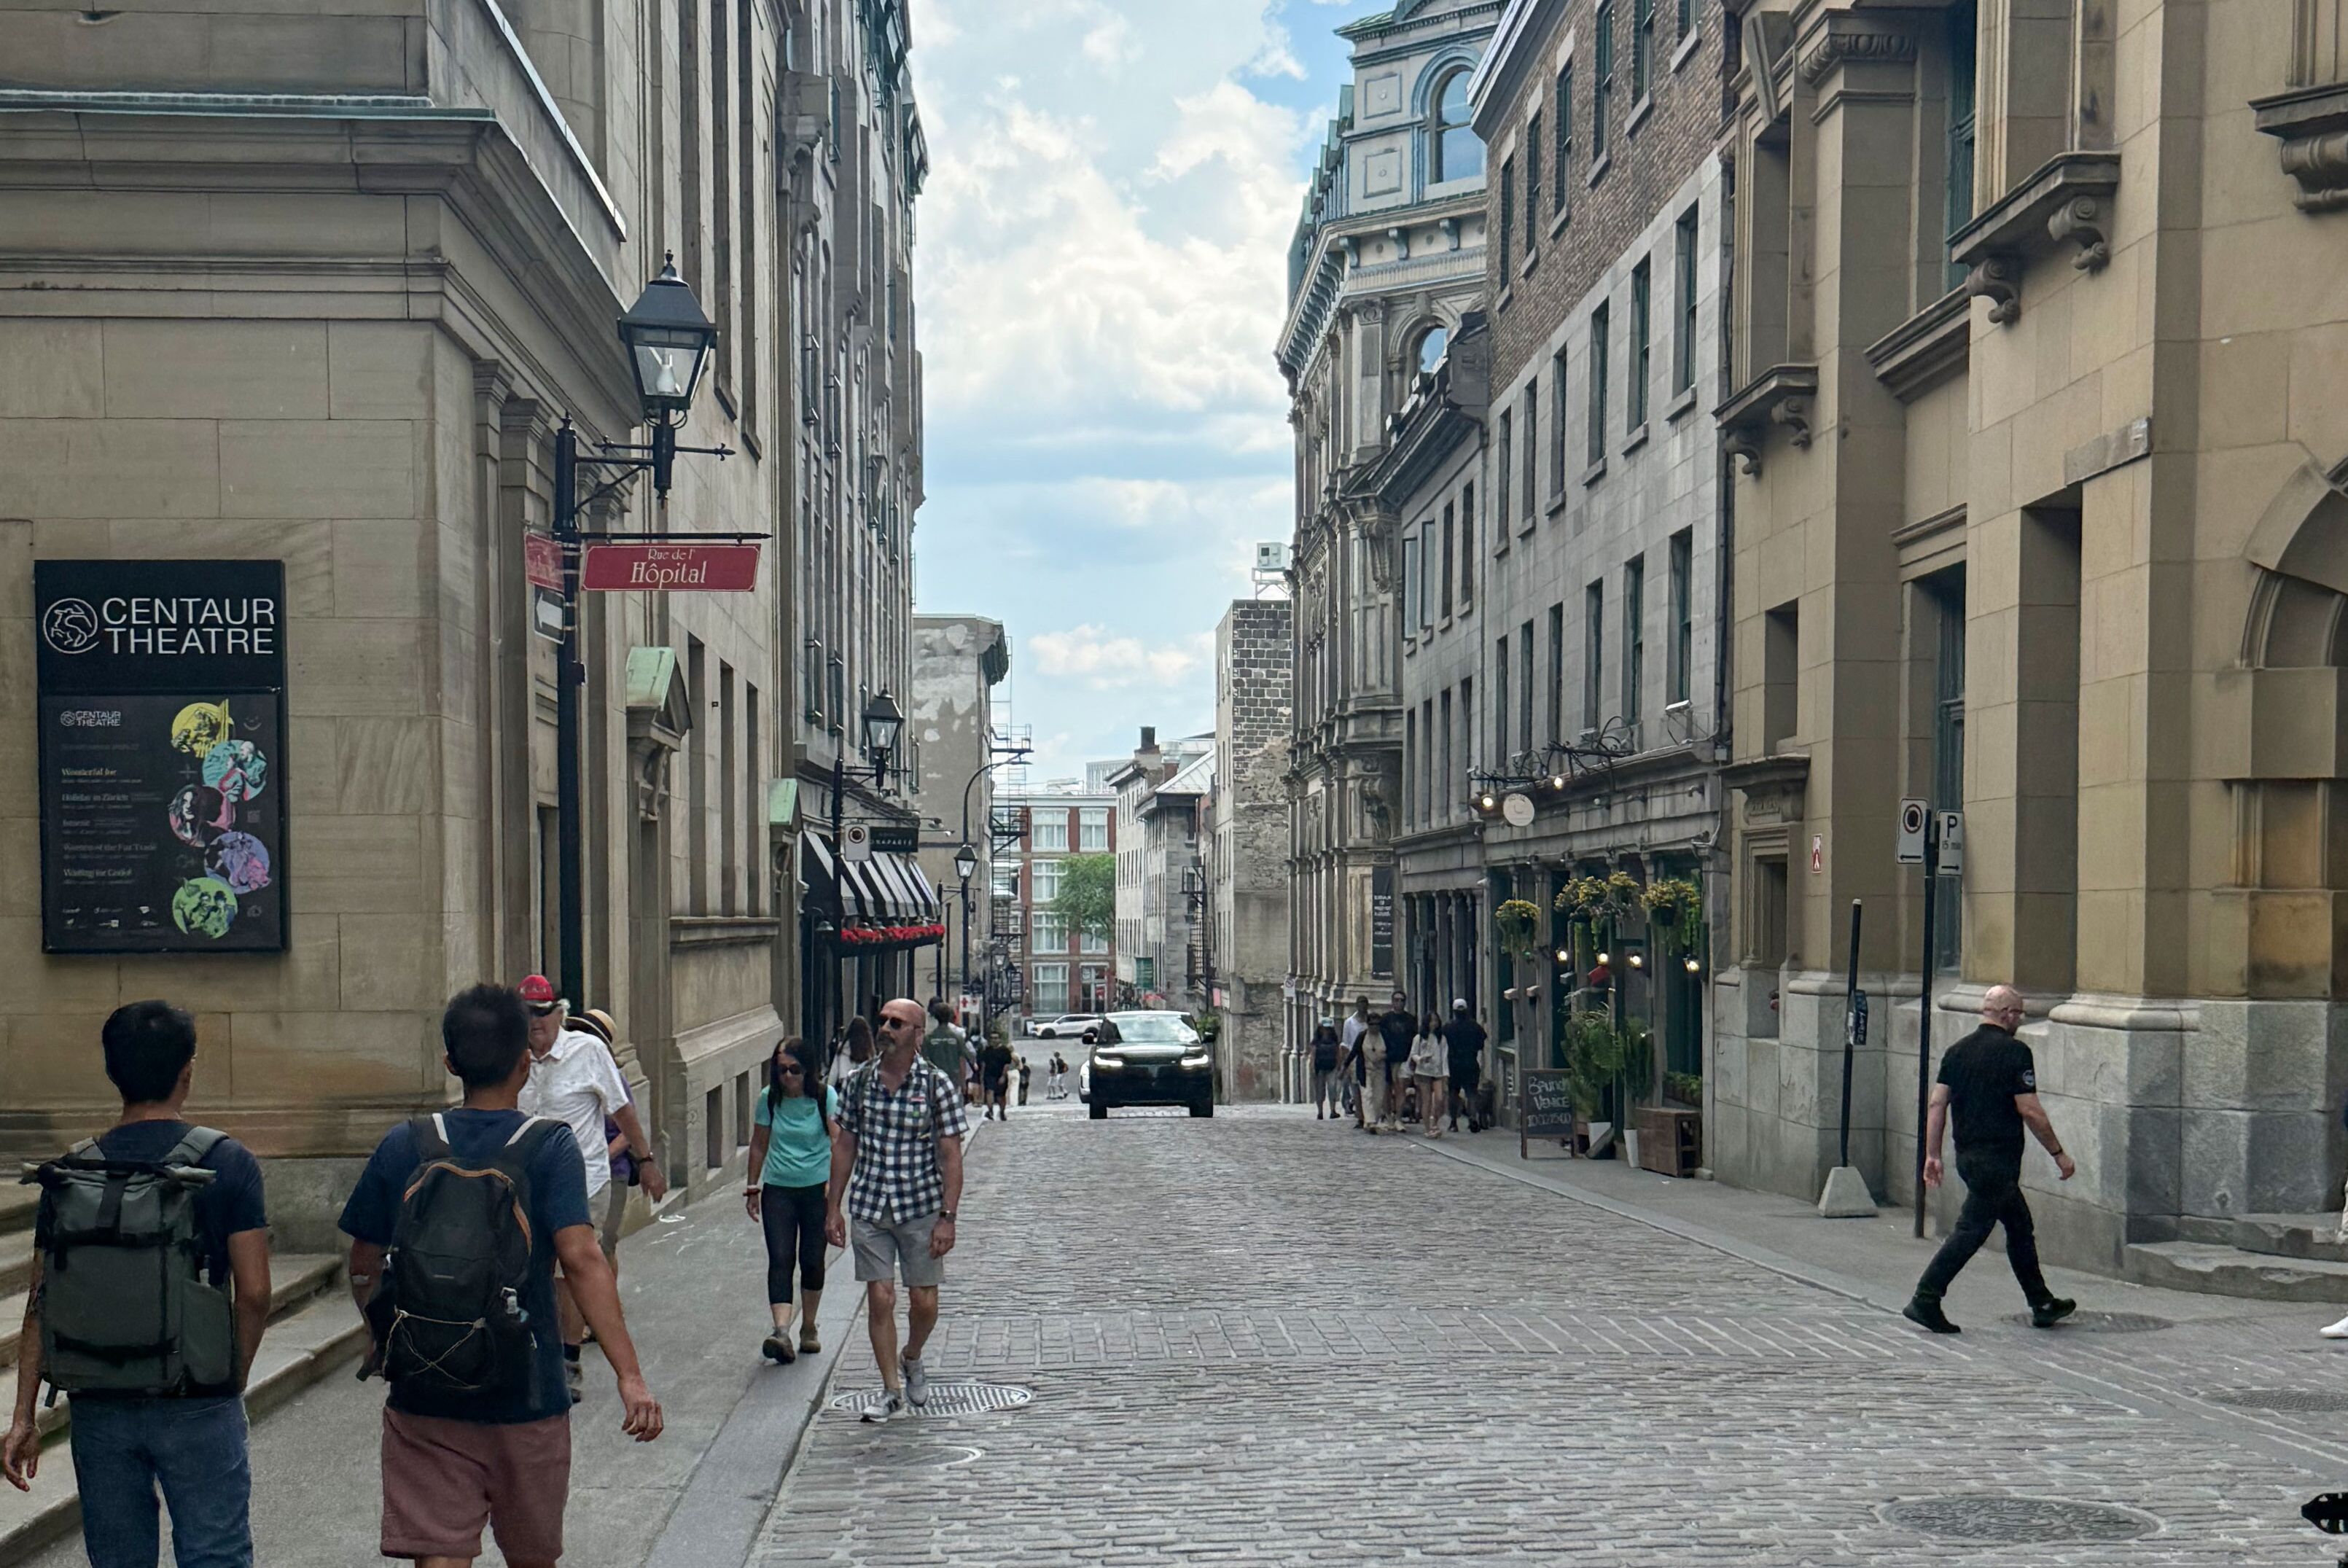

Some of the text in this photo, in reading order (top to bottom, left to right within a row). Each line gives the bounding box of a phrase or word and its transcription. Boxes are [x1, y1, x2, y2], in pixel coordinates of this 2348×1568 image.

[648, 548, 670, 561] Rue
[671, 548, 687, 560] de
[630, 561, 707, 590] Hôpital
[102, 598, 275, 625] CENTAUR
[104, 628, 274, 655] THEATRE
[75, 711, 121, 719] CENTAUR
[77, 719, 121, 727] THEATRE
[1947, 815, 1957, 838] P
